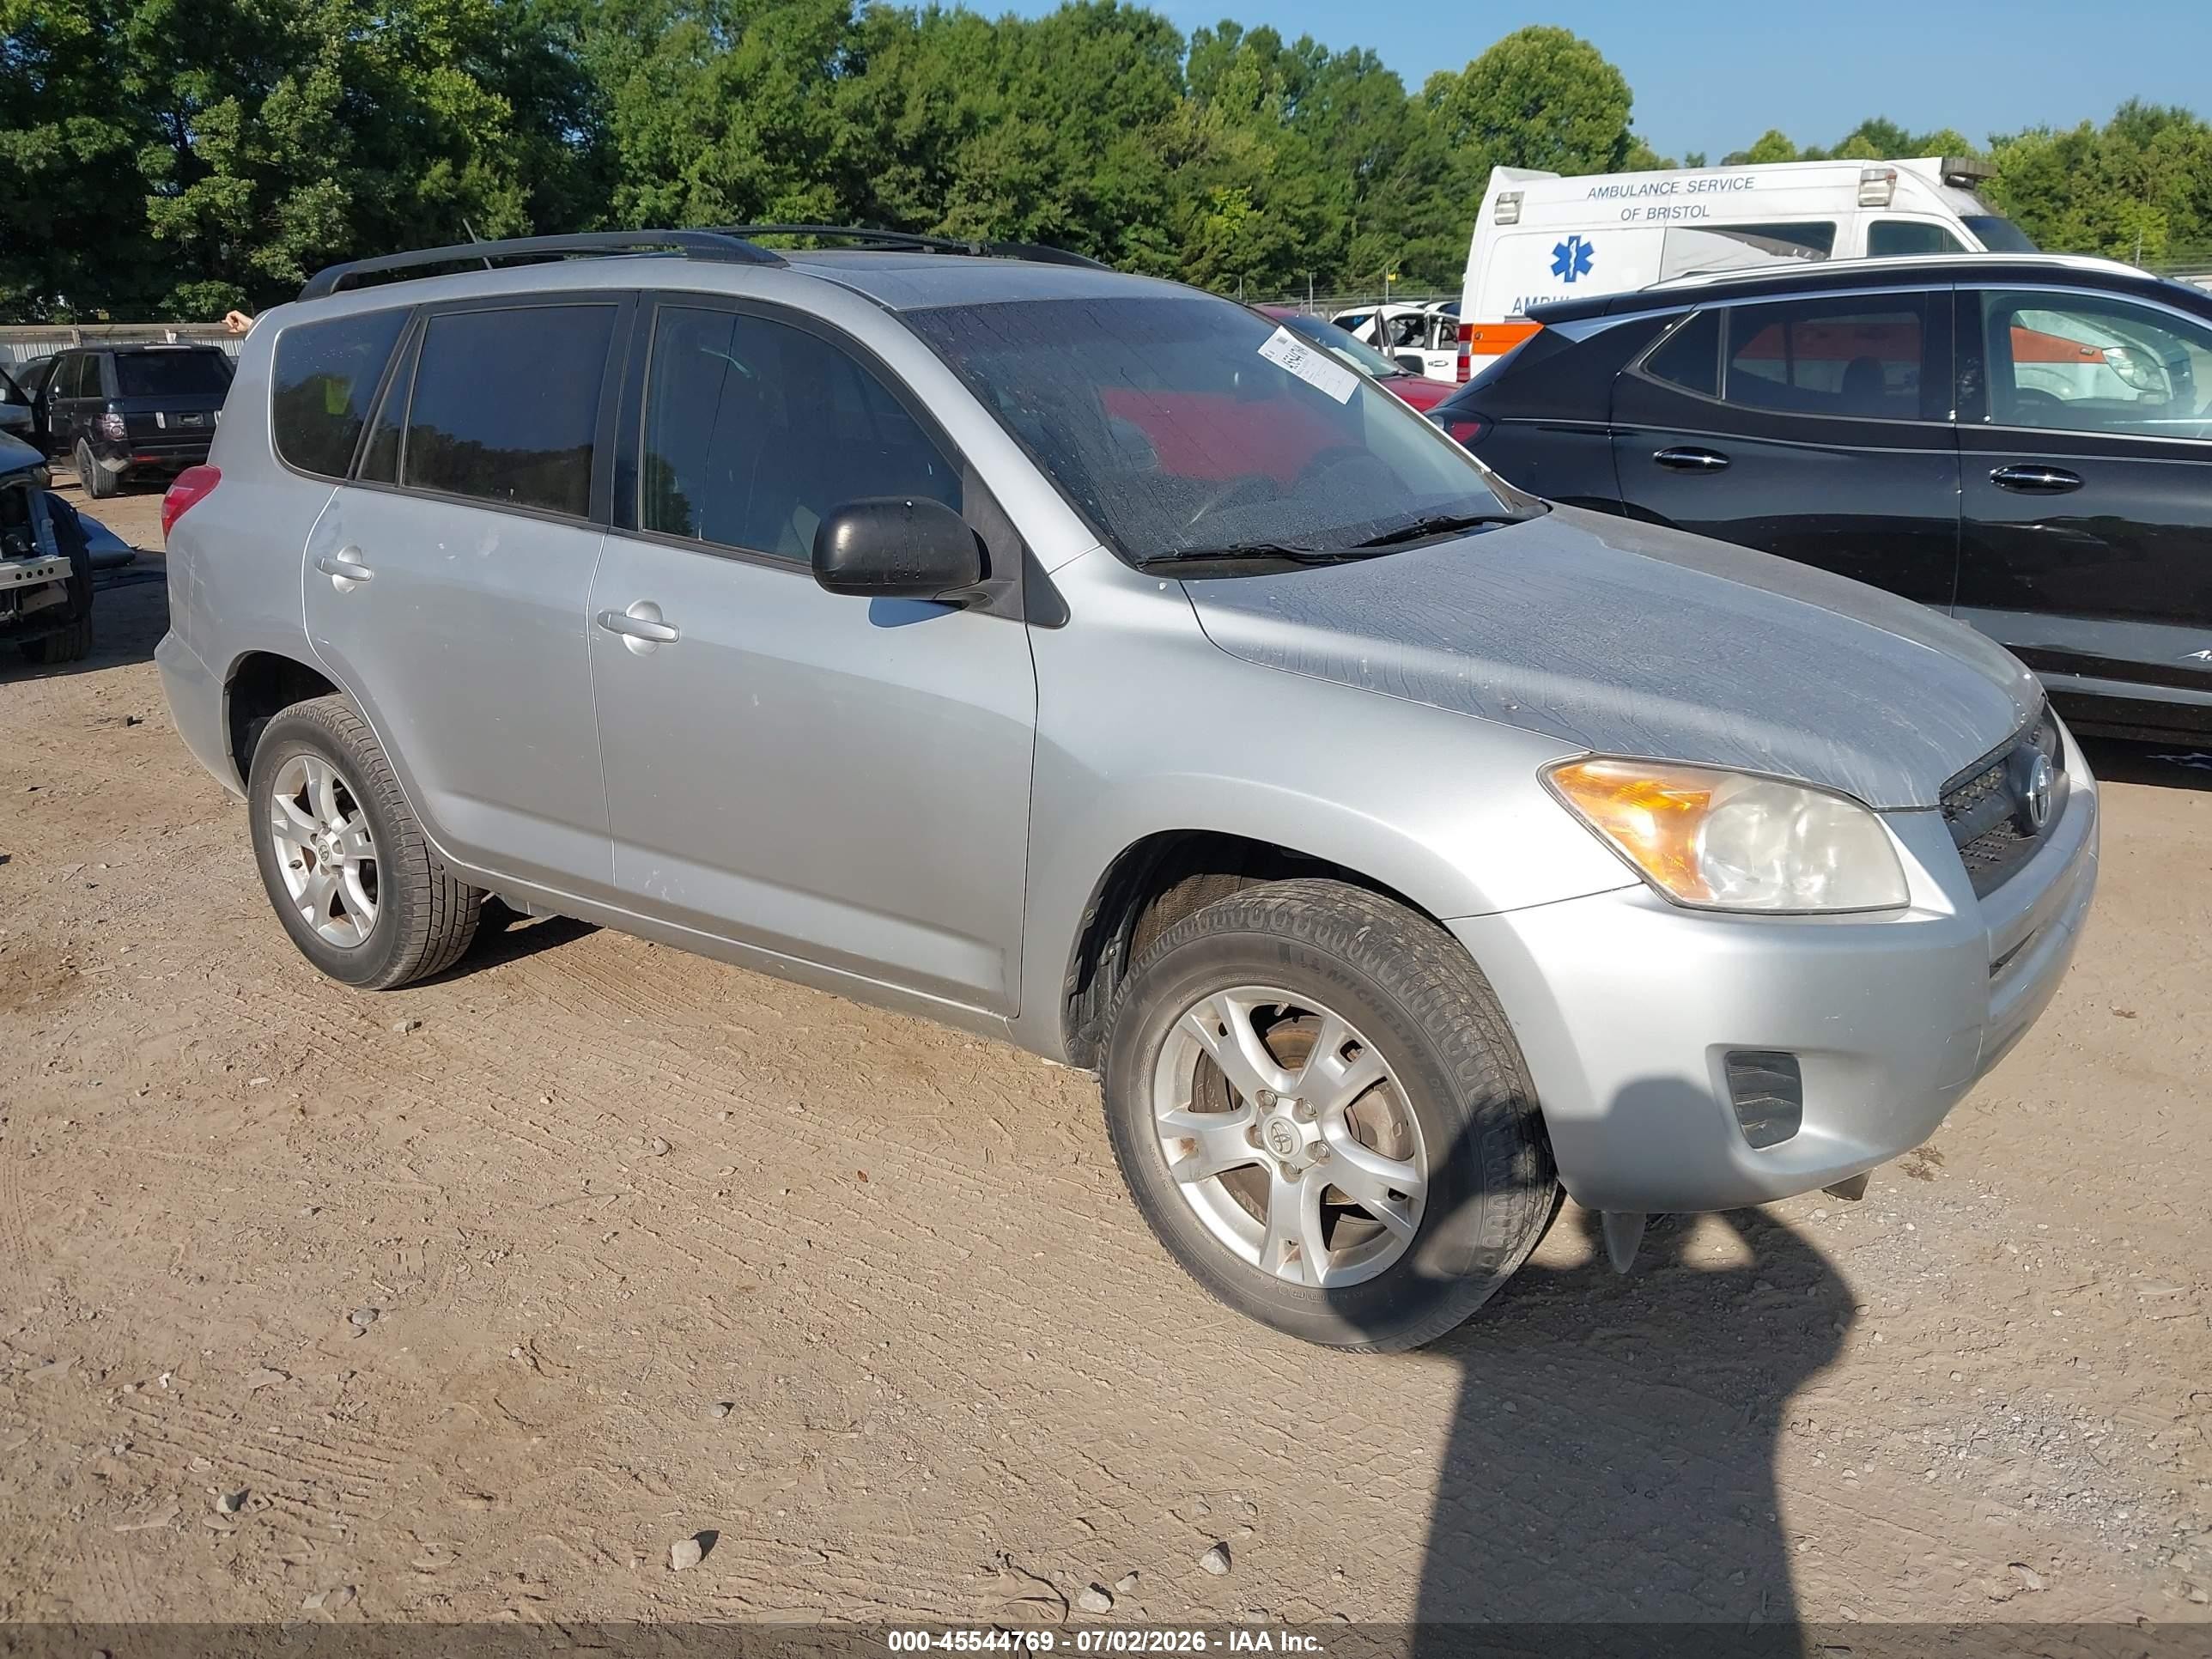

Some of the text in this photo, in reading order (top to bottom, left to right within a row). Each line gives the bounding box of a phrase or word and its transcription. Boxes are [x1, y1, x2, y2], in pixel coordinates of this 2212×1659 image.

[1587, 177, 1756, 199] AMBULANCE SERVICE
[1620, 204, 1711, 221] OF BRISTOL
[1330, 968, 1425, 1060] MICHELIN
